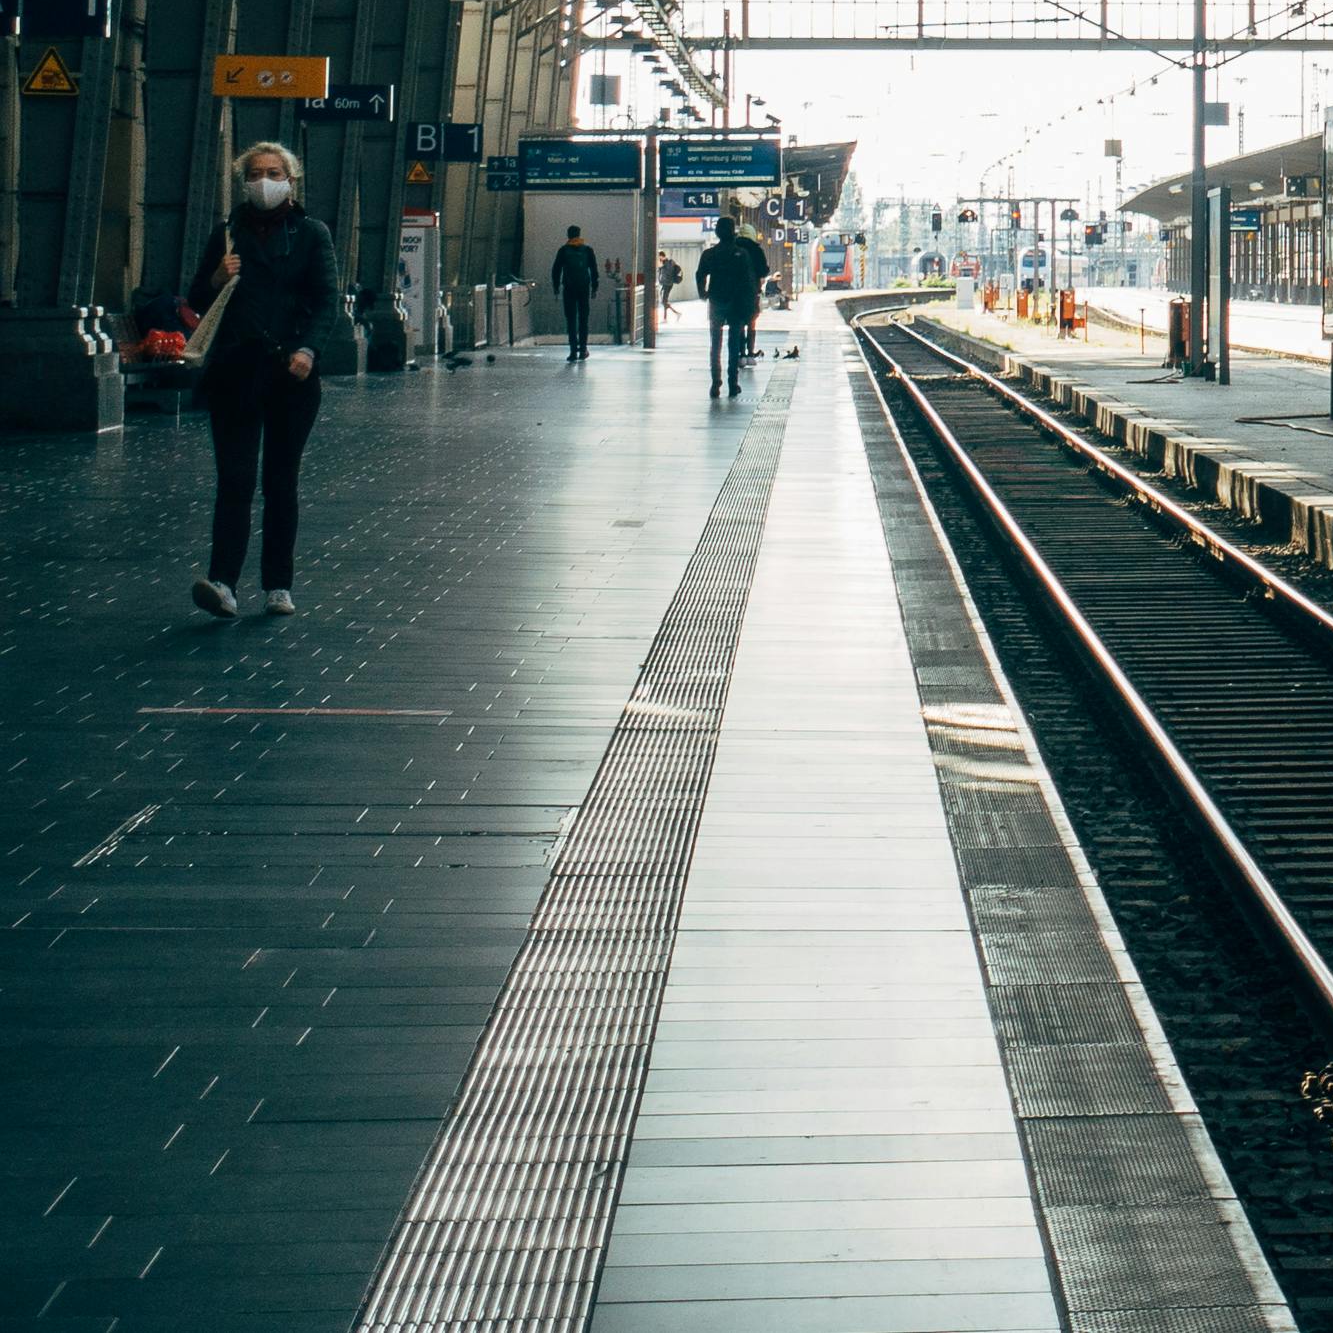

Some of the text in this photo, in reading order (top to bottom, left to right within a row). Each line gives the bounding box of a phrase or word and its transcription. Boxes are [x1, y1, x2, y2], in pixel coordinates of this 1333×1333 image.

[334, 99, 360, 109] 60m
[416, 125, 479, 153] B 1
[504, 157, 517, 168] 1a
[700, 193, 713, 204] 1a
[767, 199, 806, 217] C 1
[775, 228, 801, 242] D 1
